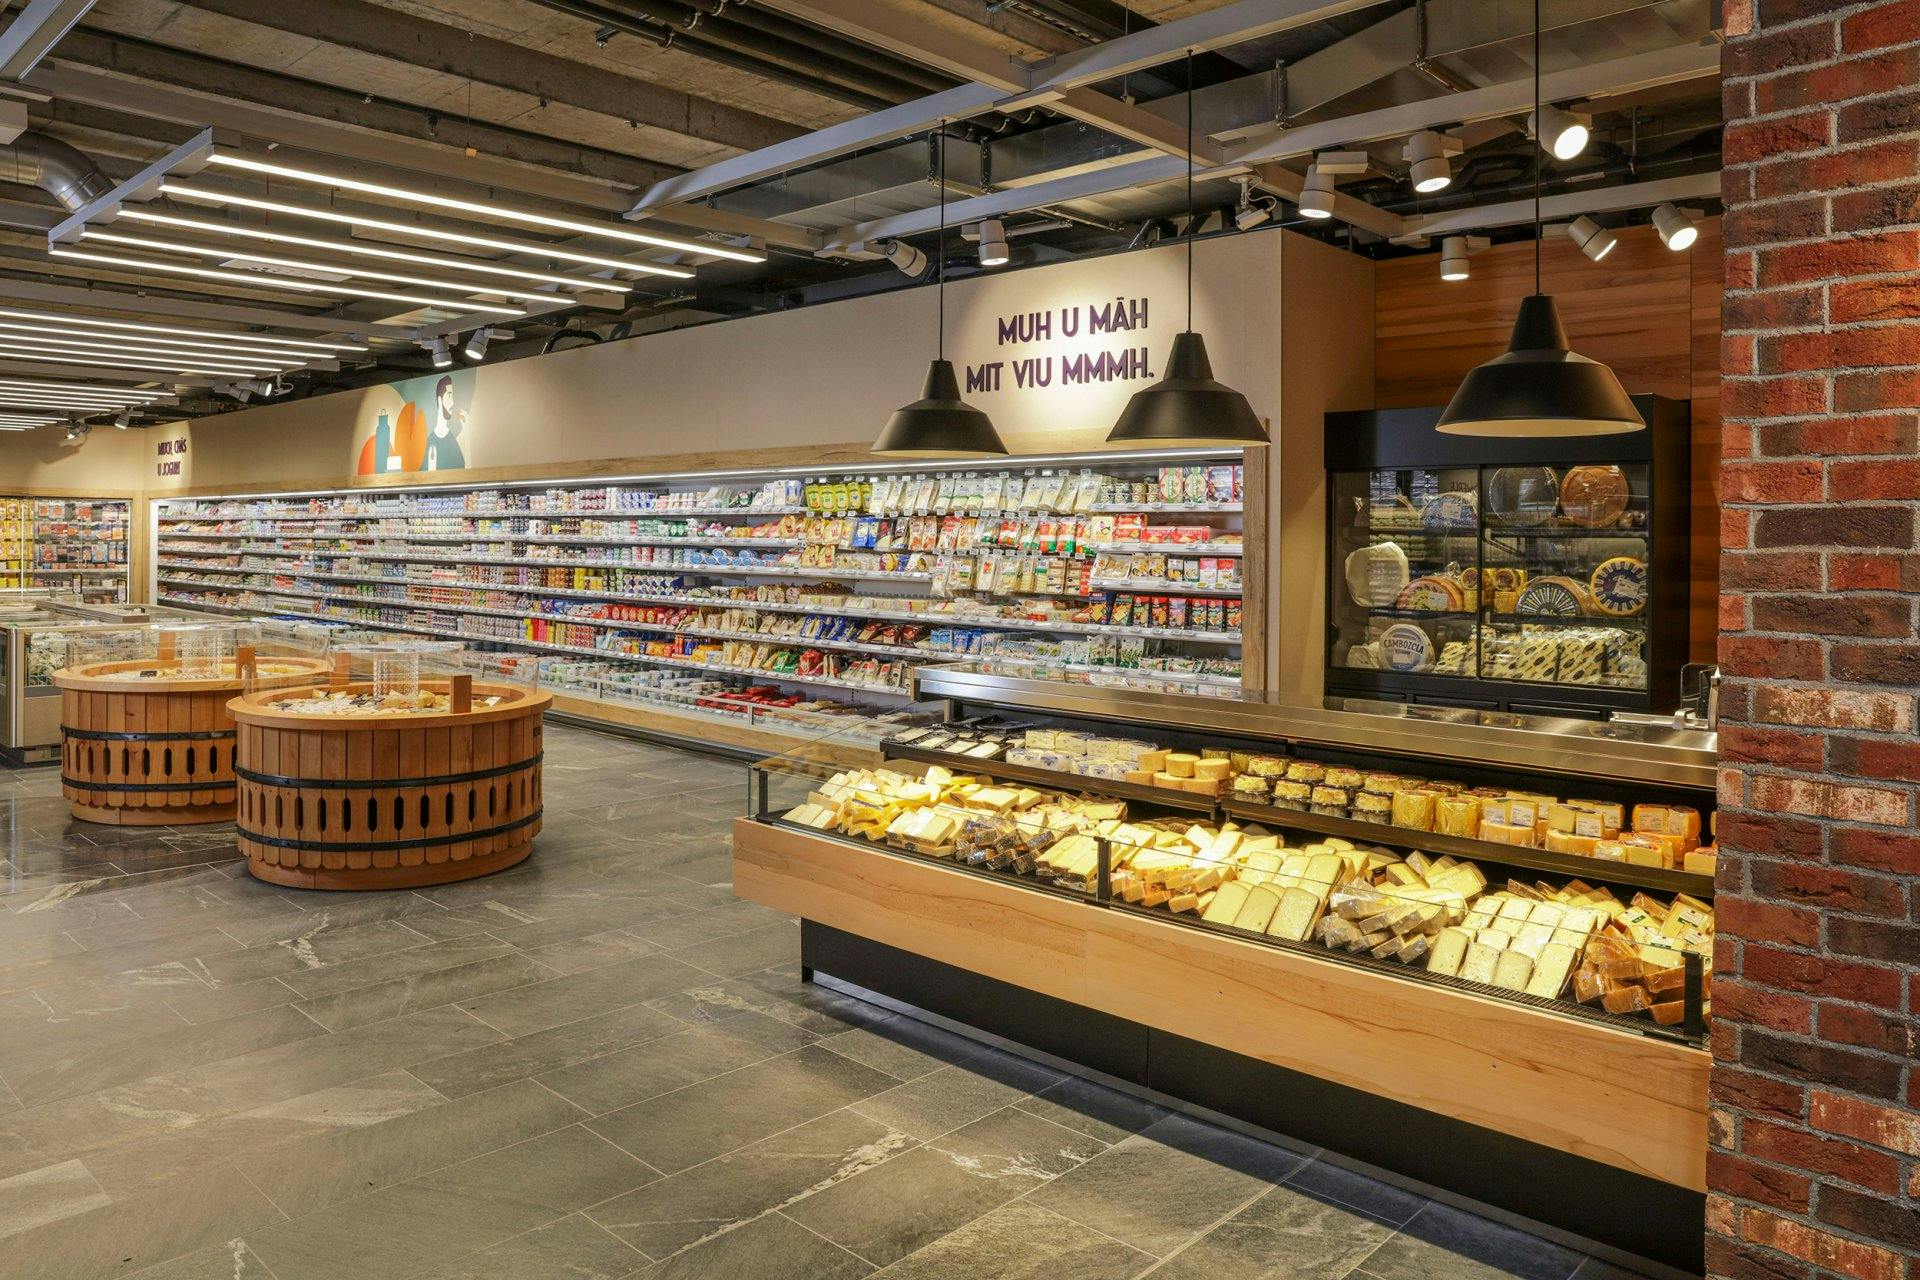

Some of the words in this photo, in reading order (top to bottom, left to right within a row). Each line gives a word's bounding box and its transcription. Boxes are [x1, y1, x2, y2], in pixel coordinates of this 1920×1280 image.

[999, 311, 1051, 345] MUH
[1062, 307, 1079, 337] U
[1089, 296, 1148, 334] MÄH
[966, 362, 1003, 393] MIT
[1012, 357, 1052, 388] VIU
[1062, 347, 1154, 385] MMMH.
